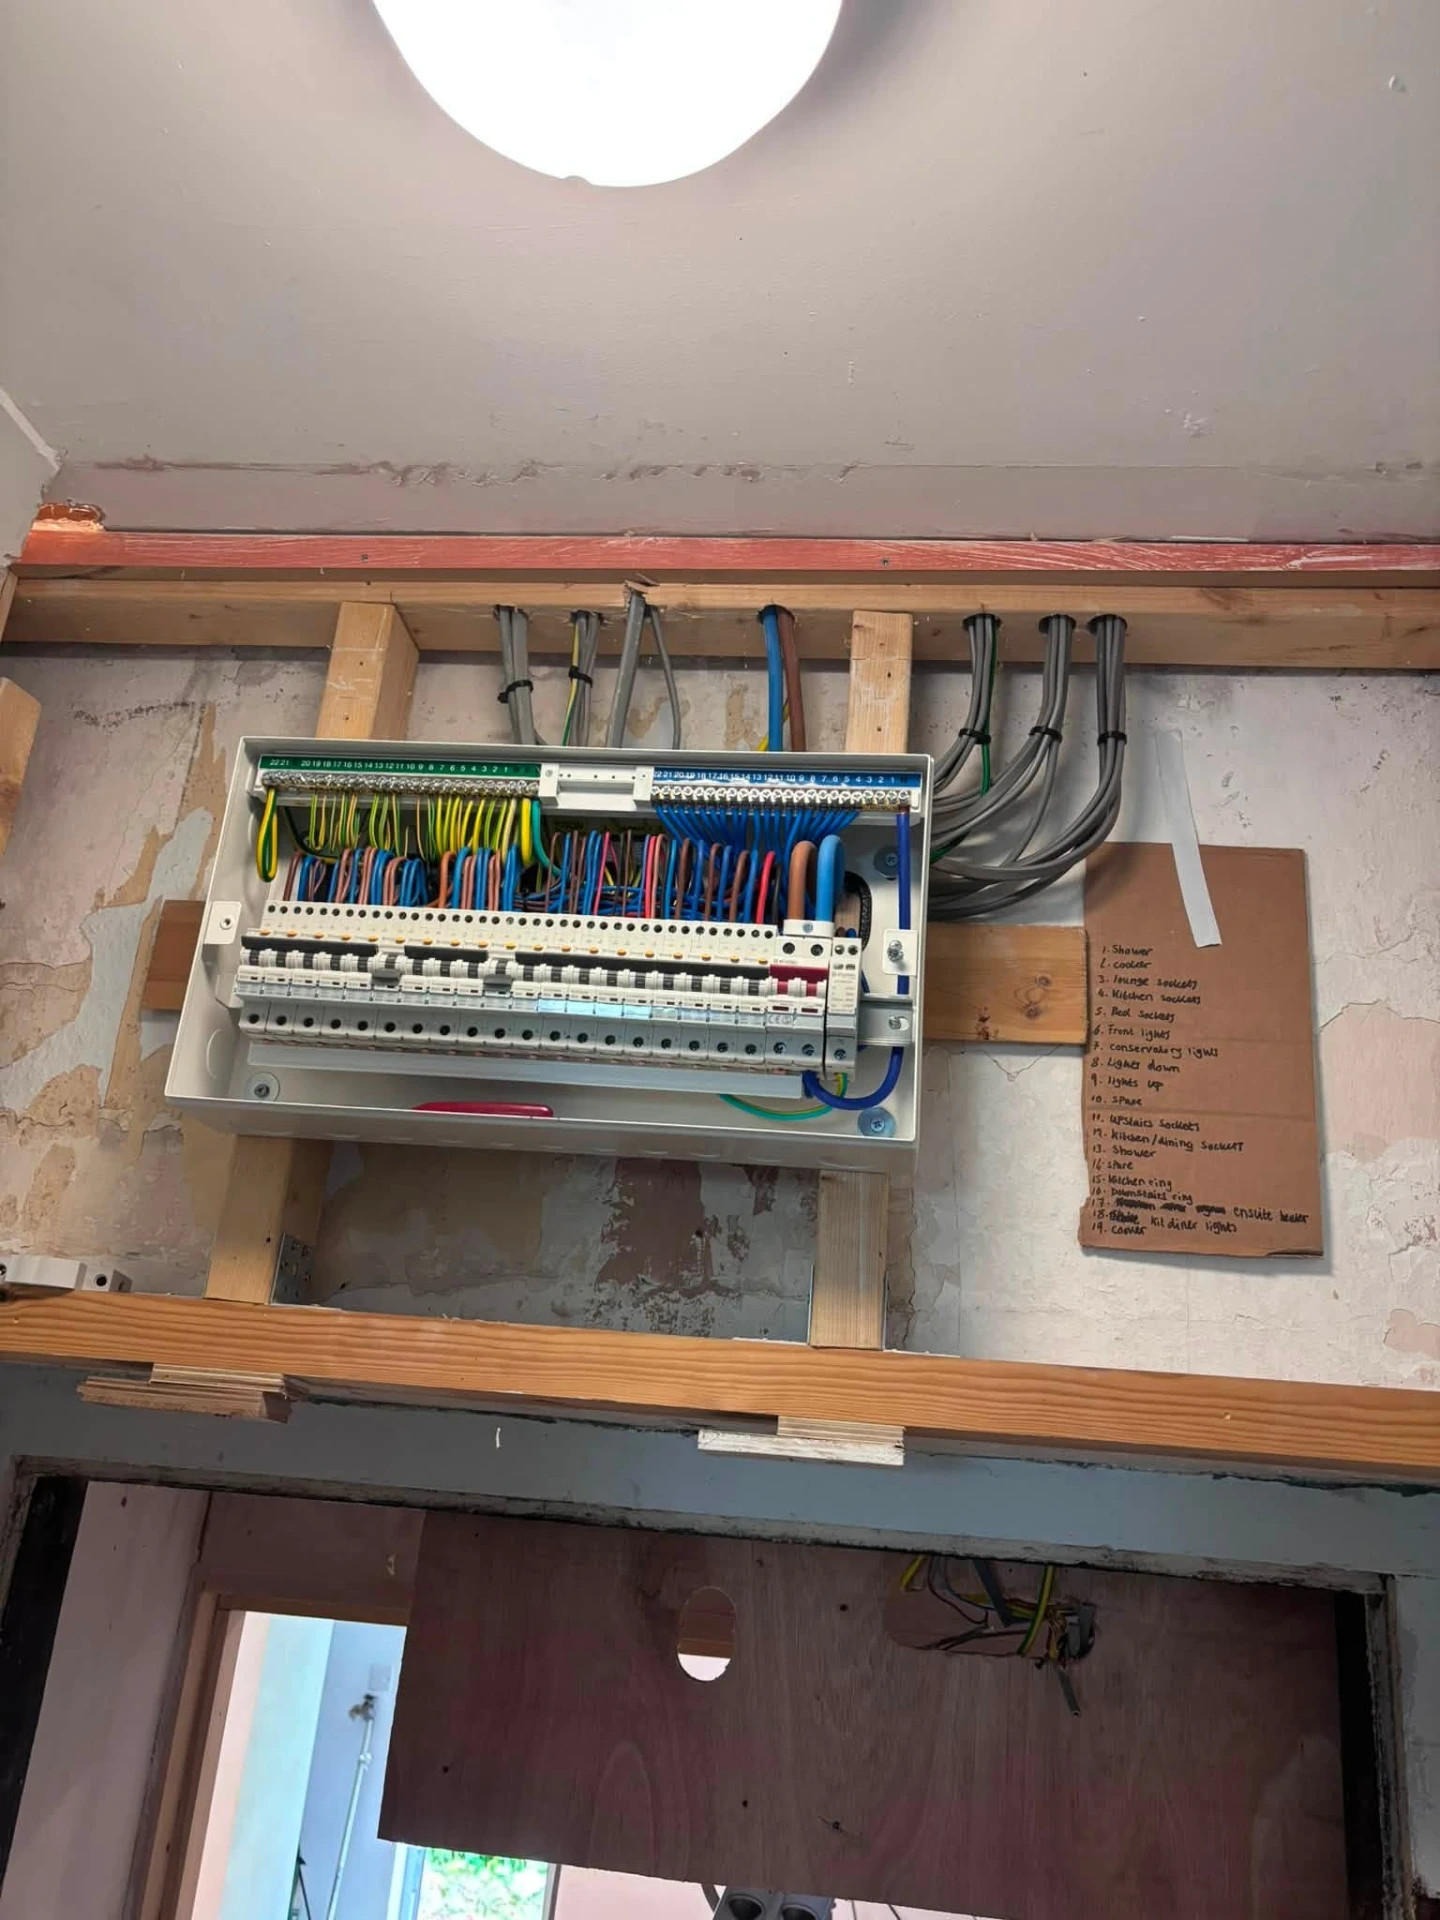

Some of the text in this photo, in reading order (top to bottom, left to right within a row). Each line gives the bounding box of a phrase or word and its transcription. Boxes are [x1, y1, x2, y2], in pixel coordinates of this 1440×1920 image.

[1112, 945, 1153, 956] Shower
[1148, 1059, 1180, 1073] down
[1147, 1080, 1163, 1091] up
[1112, 1146, 1156, 1158] Shower
